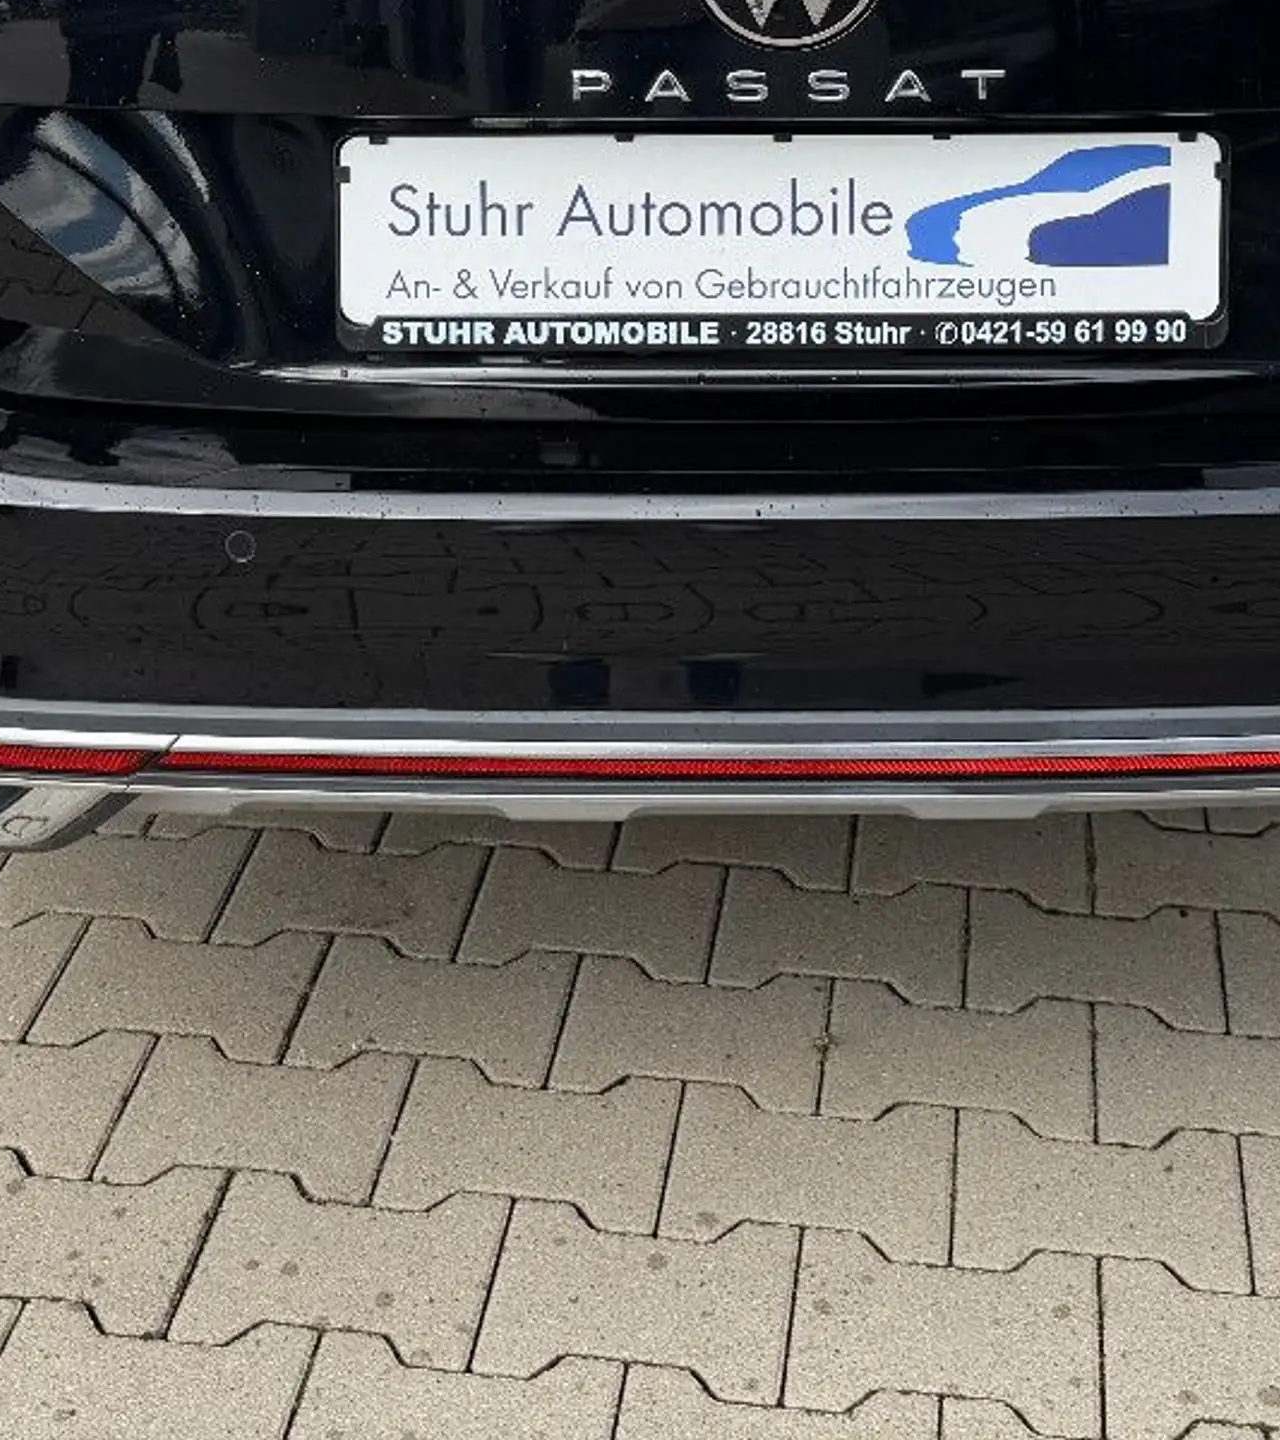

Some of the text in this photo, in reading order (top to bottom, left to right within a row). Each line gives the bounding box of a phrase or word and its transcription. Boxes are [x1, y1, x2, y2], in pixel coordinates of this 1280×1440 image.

[571, 69, 1006, 102] PASSAT
[387, 178, 894, 237] Stuhr Automobile
[386, 265, 1057, 307] An- & Verkauf von Gebrauchtfahrzeugen
[382, 321, 495, 346] STUHR
[503, 321, 720, 346] AUTOMOBILE
[745, 321, 827, 346] 28816
[834, 319, 912, 346] Stuhr
[1074, 319, 1105, 343] 61
[1114, 318, 1148, 343] 99
[1155, 318, 1187, 343] 90
